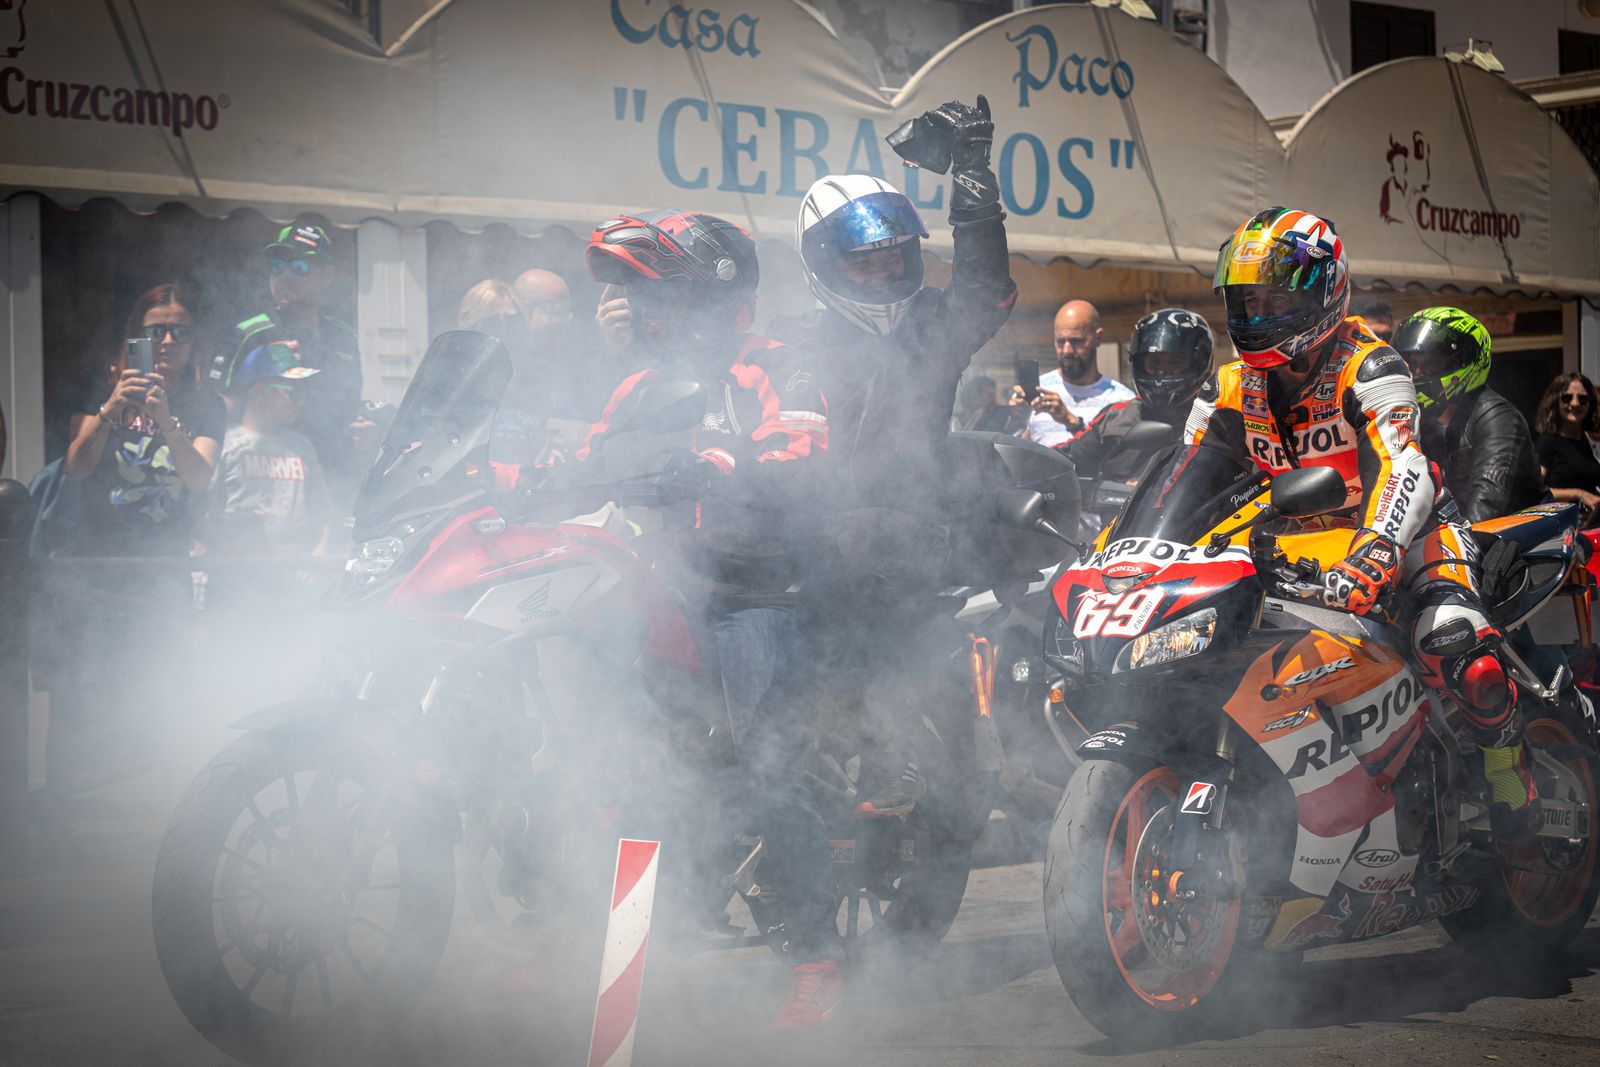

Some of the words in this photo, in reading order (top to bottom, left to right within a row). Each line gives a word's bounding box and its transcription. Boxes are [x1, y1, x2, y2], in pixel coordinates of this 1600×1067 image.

[609, 0, 762, 59] Casa
[1006, 23, 1135, 108] Paco
[1416, 198, 1521, 244] Cruzcampo
[1385, 469, 1420, 541] REPSOL
[1090, 539, 1197, 567] REPSOL
[1368, 548, 1391, 563] 69
[1107, 565, 1143, 575] HONDA
[1073, 589, 1165, 640] 69
[1134, 600, 1154, 630] PAQUIRO
[1284, 675, 1428, 779] REPSOL
[1299, 855, 1341, 866] HONDA
[1358, 850, 1396, 864] Arai
